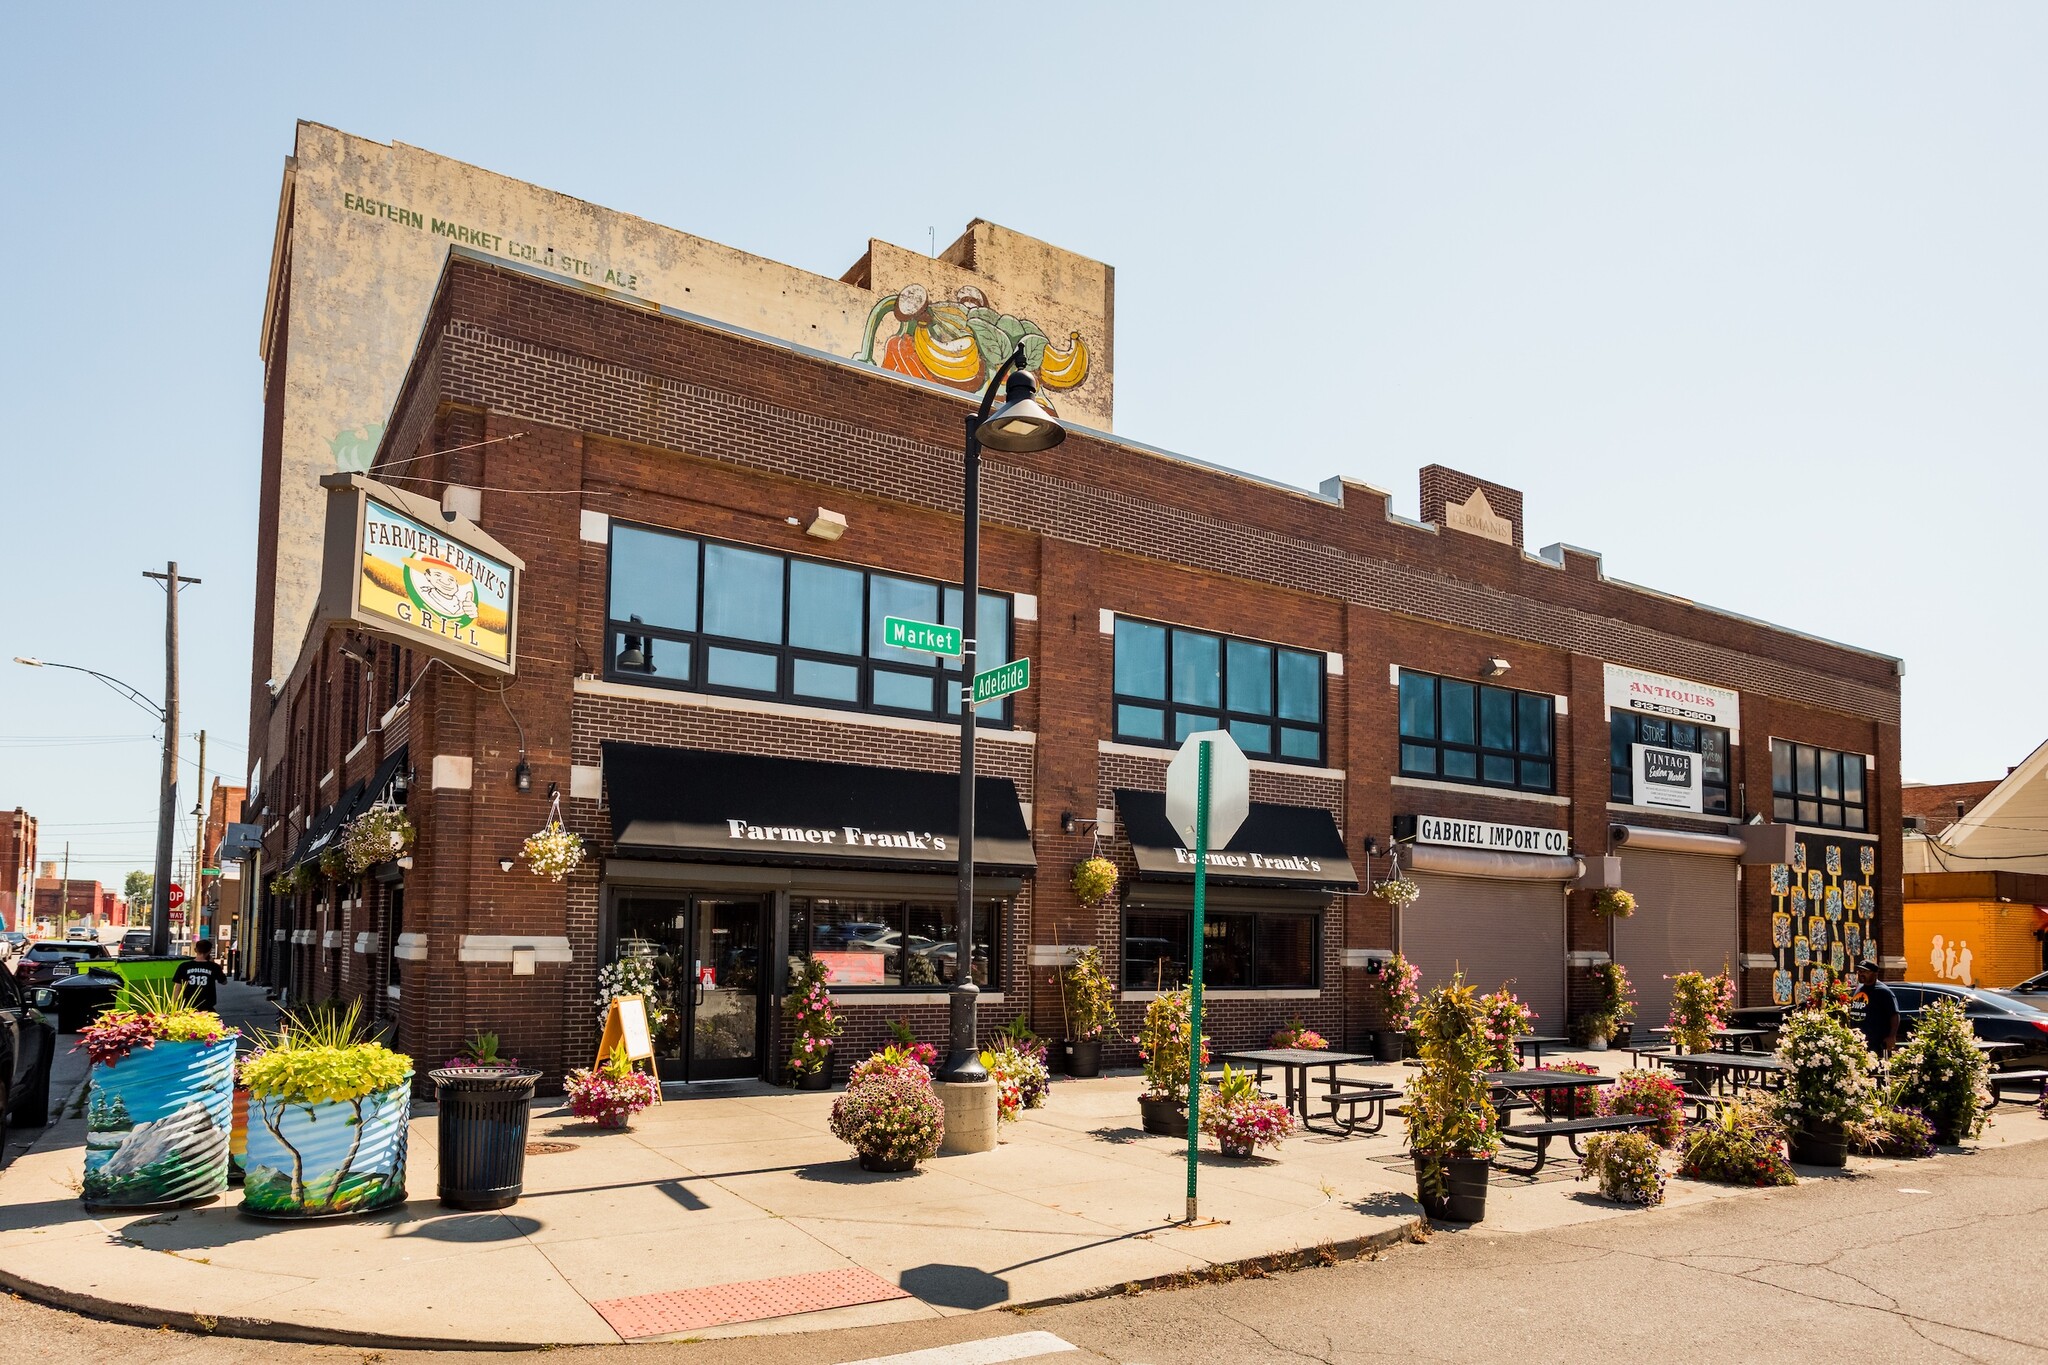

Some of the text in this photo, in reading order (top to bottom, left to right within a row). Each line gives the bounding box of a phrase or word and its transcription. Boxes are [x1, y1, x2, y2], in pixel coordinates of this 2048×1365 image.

[344, 192, 423, 230] EASTERN
[431, 217, 502, 252] MARKET
[560, 256, 638, 292] STOAGE
[368, 522, 508, 600] FARMER FRANK'S
[397, 602, 479, 647] GRILL
[893, 623, 953, 650] Market
[978, 666, 1024, 698] Adelaide
[1630, 682, 1716, 708] ANTIQUES
[1633, 700, 1713, 722] 313-259-0600
[1646, 752, 1690, 769] VINTAGE
[1648, 765, 1687, 782] Eastern Market
[726, 818, 947, 851] Farmer Frank's
[1422, 819, 1567, 852] GABRIEL IMPORT CO.
[1249, 852, 1322, 872] Frank's
[169, 892, 183, 901] OP
[188, 974, 208, 986] 313
